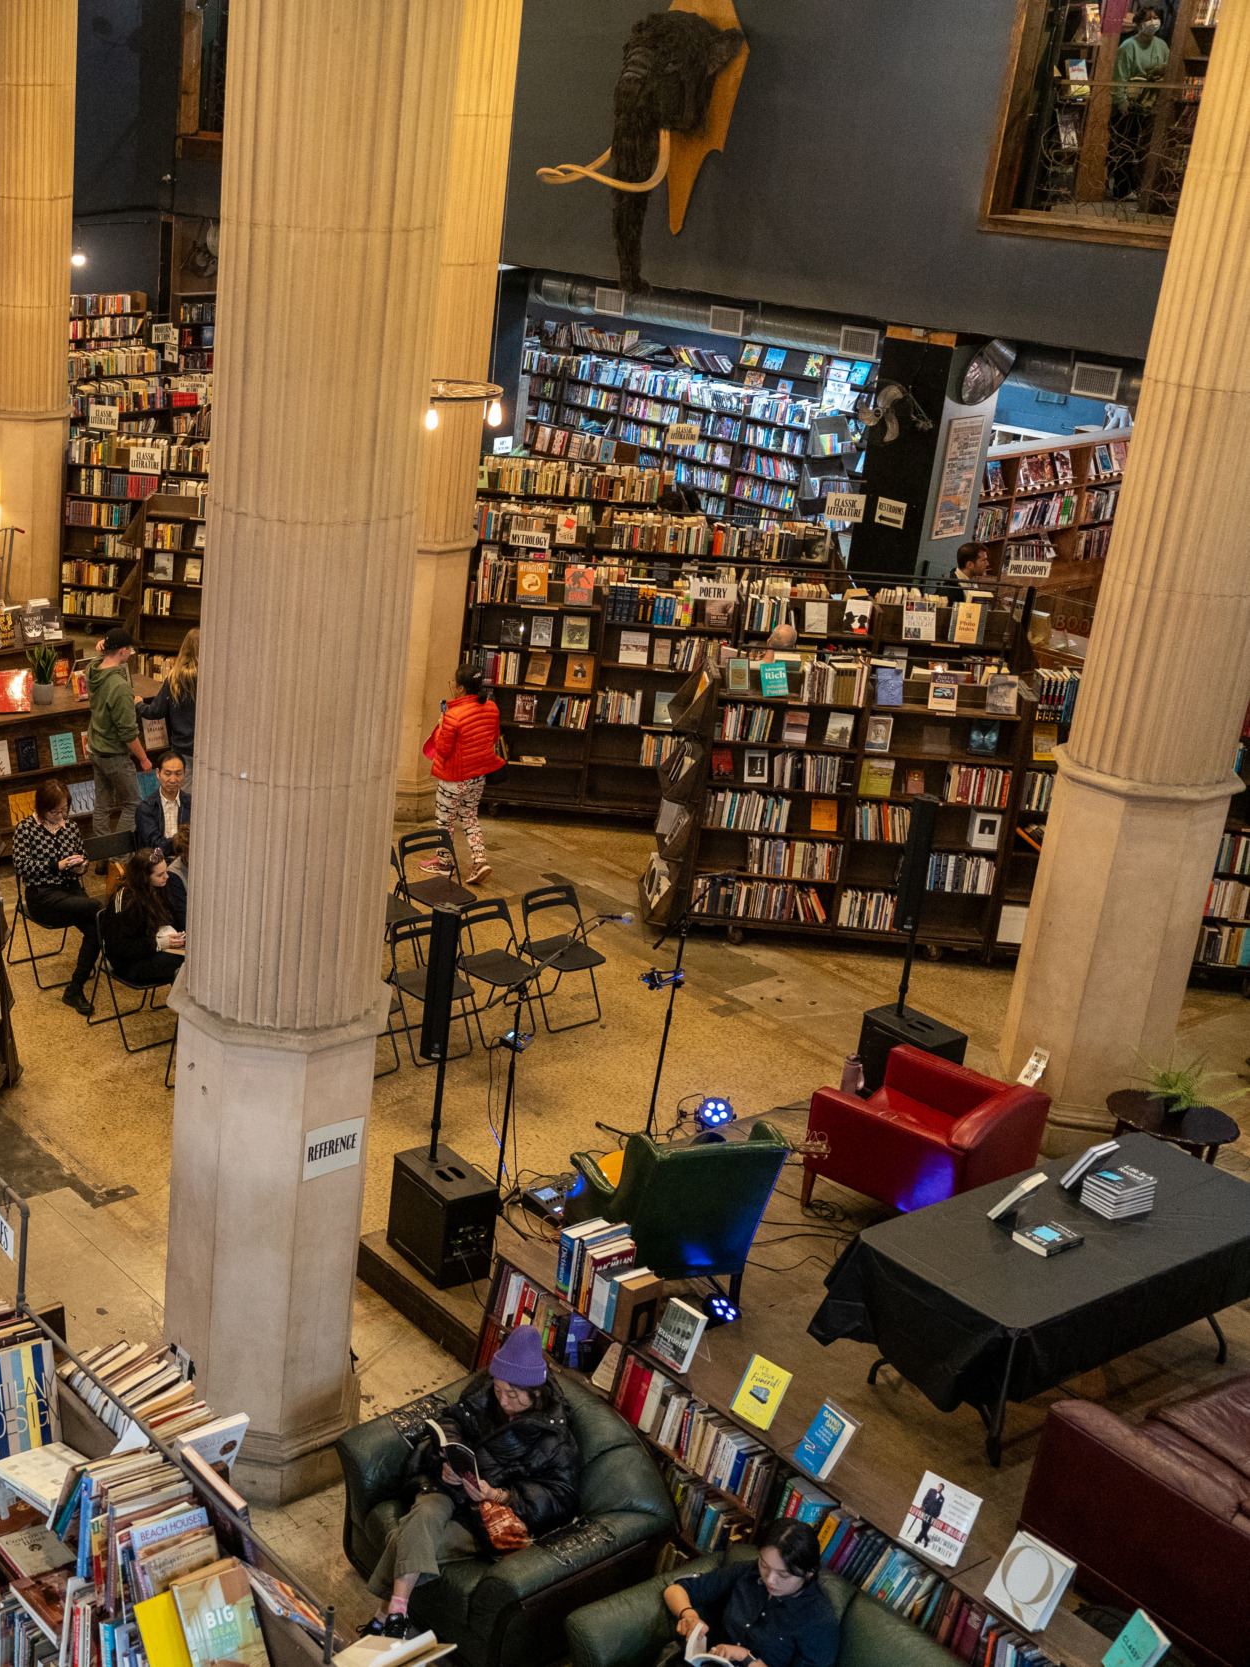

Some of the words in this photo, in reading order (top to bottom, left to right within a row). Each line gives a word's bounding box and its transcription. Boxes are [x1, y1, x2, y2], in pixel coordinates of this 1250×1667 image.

[154, 325, 172, 335] MODERN
[154, 333, 171, 342] FICTION
[95, 409, 113, 419] CLASSIC
[90, 415, 117, 427] LITERATURE
[676, 426, 693, 435] CLASSIC
[670, 432, 697, 442] LITERATURE
[136, 451, 155, 461] CLASSIC
[130, 459, 160, 471] LITERATURE
[834, 497, 857, 509] CLASSIC
[878, 501, 905, 516] RESTROOMS
[826, 505, 862, 518] LITERATURE
[511, 533, 548, 546] MYTHOLOGY
[519, 563, 547, 573] MYTHOLOGY
[1009, 563, 1049, 576] PHILOSOPHY
[699, 586, 728, 599] POETRY
[907, 619, 932, 628] THOUGHT
[765, 671, 786, 680] Rich
[307, 1132, 358, 1163] REFERENCE
[556, 1246, 568, 1283] Dictionary
[657, 1327, 689, 1351] Etiquette
[751, 1372, 782, 1389] Funeral!
[909, 1505, 931, 1523] ADVANCE
[931, 1516, 944, 1530] YOUR
[140, 1523, 168, 1542] BEACH
[168, 1512, 203, 1533] HOUSES
[22, 1536, 47, 1547] HOME
[205, 1605, 235, 1629] BIG
[1122, 1634, 1141, 1661] CLASSY
